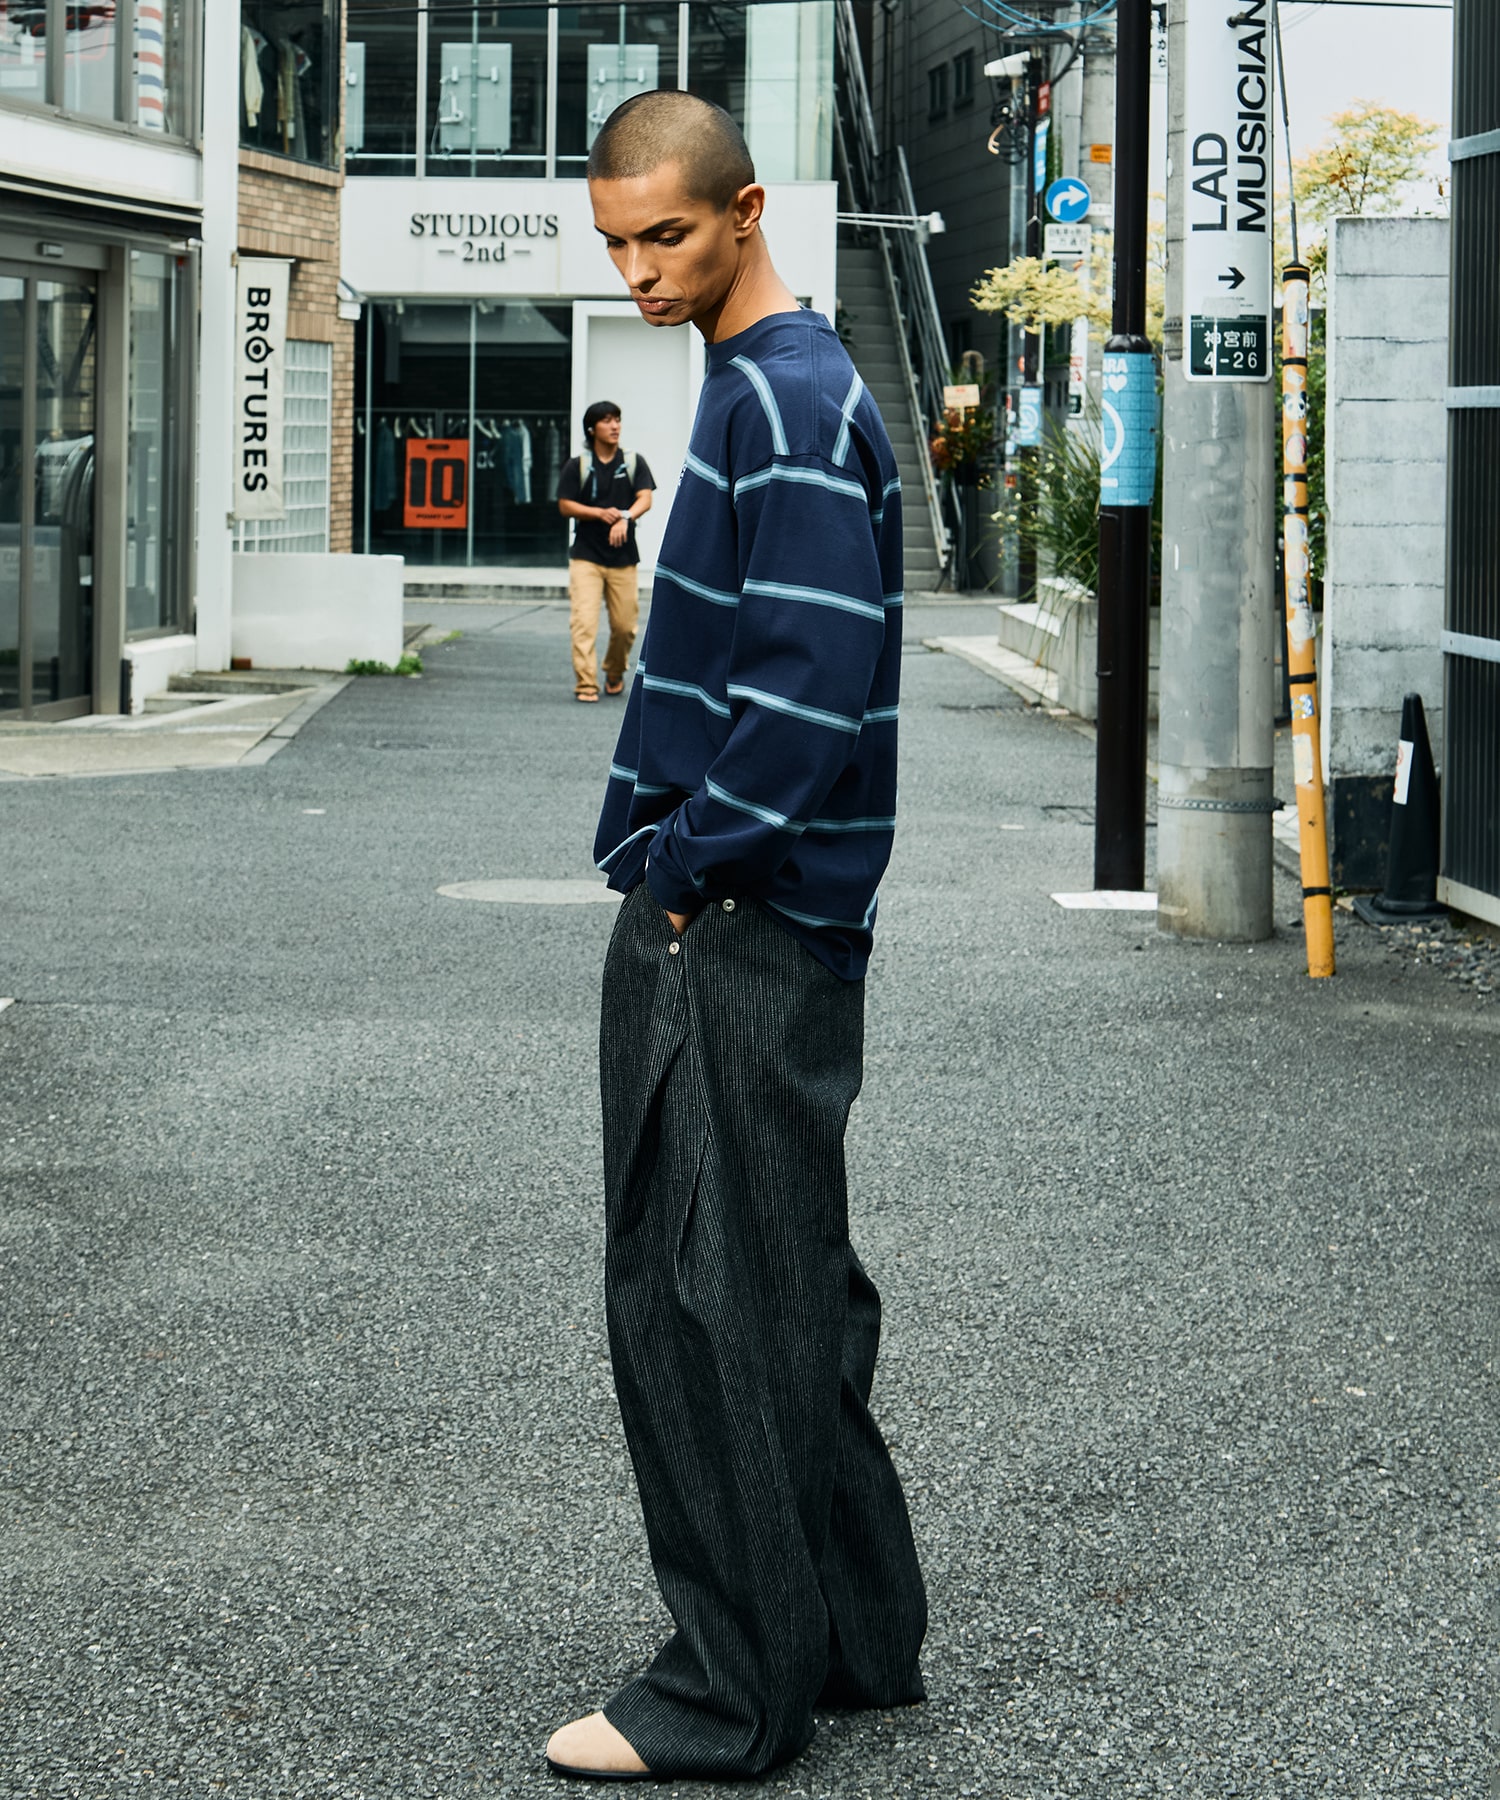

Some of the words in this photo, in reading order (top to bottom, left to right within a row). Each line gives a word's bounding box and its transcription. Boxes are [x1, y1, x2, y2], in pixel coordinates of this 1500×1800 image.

[1236, 0, 1266, 233] MUSICIAN
[1192, 132, 1228, 232] LAD
[410, 213, 559, 238] STUDIOUS
[462, 241, 506, 263] 2nd
[1203, 329, 1257, 348] 神宮前
[1203, 351, 1258, 369] 4-26
[243, 287, 275, 492] BROTURES
